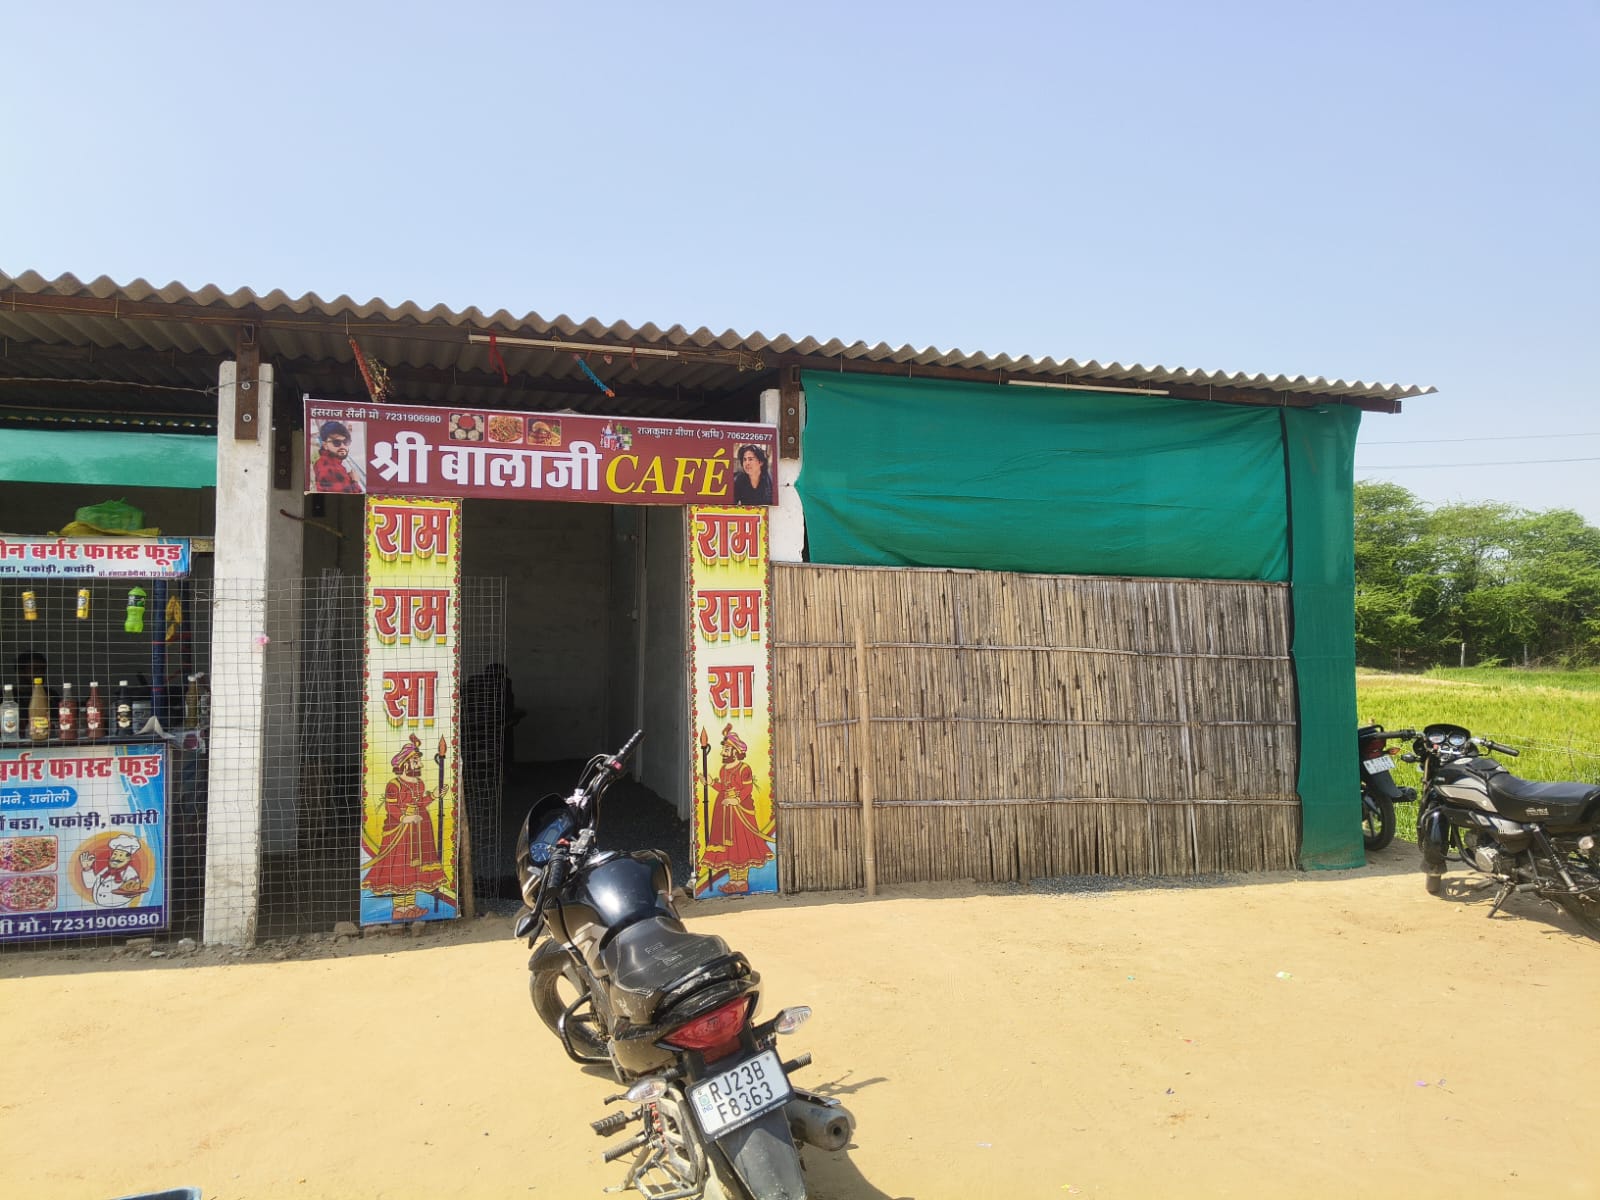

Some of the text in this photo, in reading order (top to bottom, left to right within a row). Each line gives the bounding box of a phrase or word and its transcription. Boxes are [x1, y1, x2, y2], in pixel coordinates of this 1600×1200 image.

[346, 407, 366, 419] सैनी
[386, 412, 441, 423] 7231906980
[637, 427, 673, 439] राजकुमार
[675, 427, 694, 438] मीणा
[370, 431, 731, 497] श्री बालाजी CAFÉ
[0, 538, 182, 566] ीन बर्गर फास्ट फूड
[373, 504, 452, 559] राम
[696, 513, 761, 562] राम
[372, 588, 451, 639] राम
[697, 589, 762, 638] राम
[382, 670, 438, 722] सा
[708, 665, 754, 714] सा
[49, 757, 114, 779] फास्ट
[118, 755, 161, 784] फूड
[29, 788, 71, 804] रानोली
[52, 913, 160, 931] 7231906980
[709, 1060, 765, 1103] RJ23B
[717, 1081, 773, 1124] F8363
